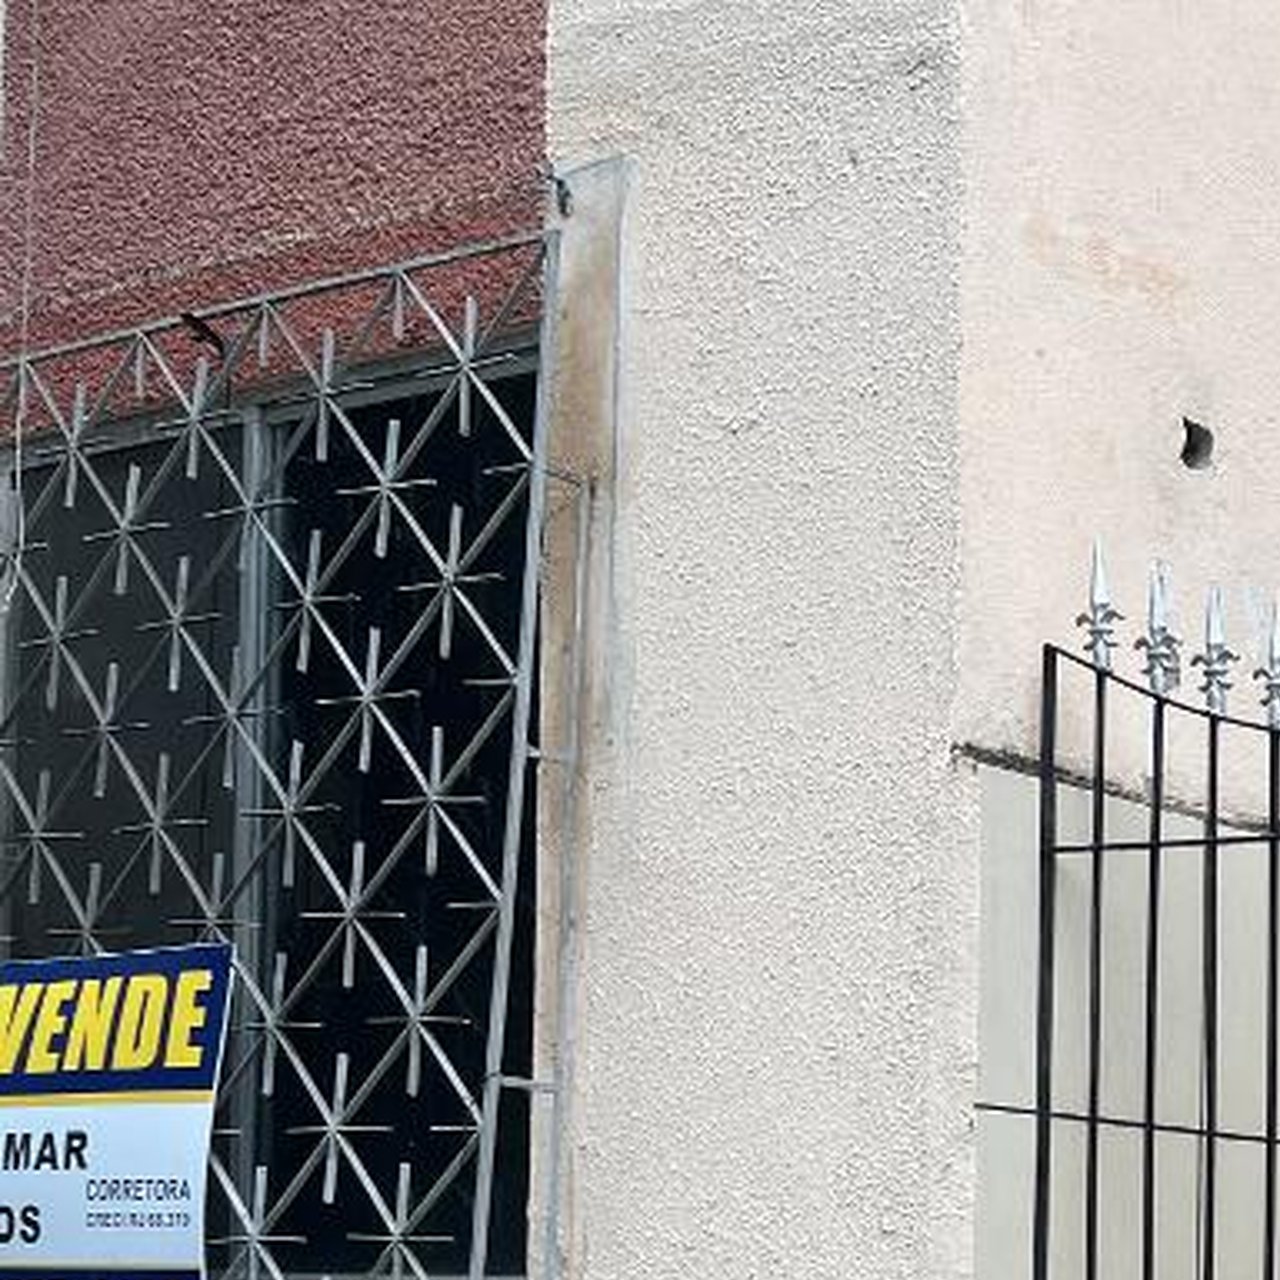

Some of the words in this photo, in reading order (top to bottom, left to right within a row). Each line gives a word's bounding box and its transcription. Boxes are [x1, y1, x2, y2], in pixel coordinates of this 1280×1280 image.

[0, 970, 212, 1074] VENDE
[3, 1130, 88, 1171] MAR
[86, 1178, 191, 1201] CORRETORA
